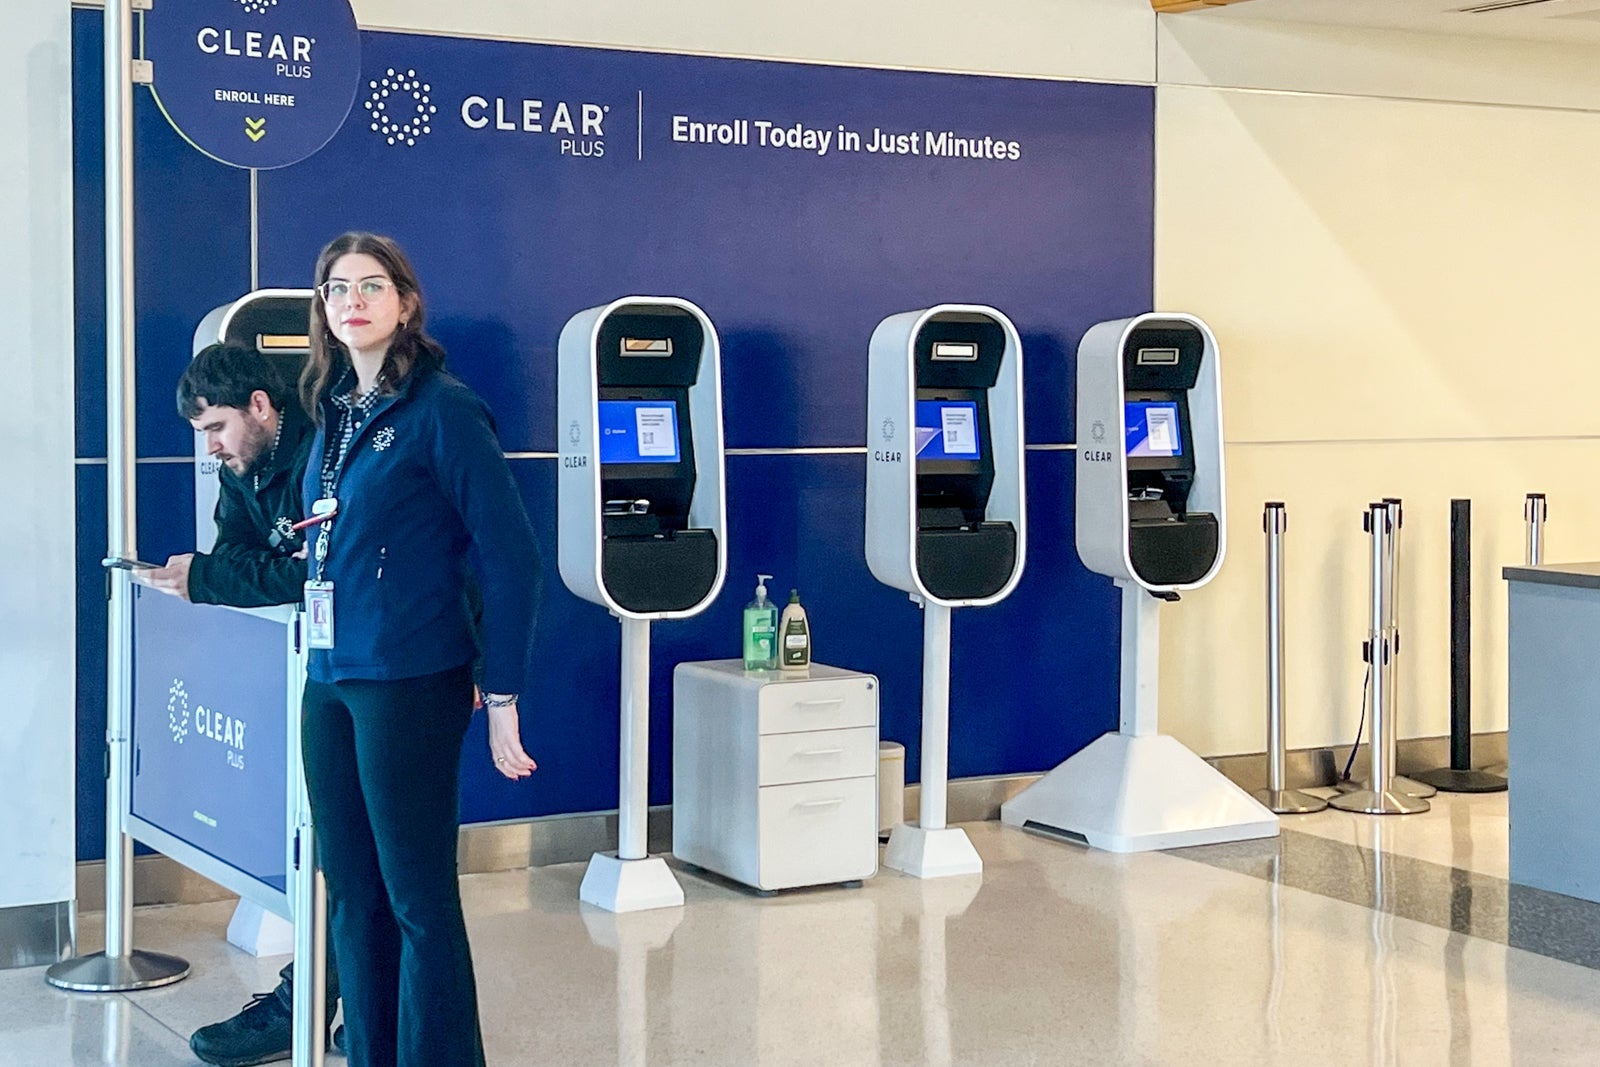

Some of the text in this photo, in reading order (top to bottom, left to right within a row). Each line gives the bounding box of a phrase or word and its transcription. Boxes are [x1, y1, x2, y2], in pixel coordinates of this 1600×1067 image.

[197, 27, 312, 62] CLEAR
[276, 63, 312, 79] PLUS
[215, 89, 295, 107] ENROLL HERE
[461, 95, 605, 136] CLEAR
[672, 115, 1021, 160] Enroll Today in Just Minutes
[560, 139, 605, 158] PLUS
[564, 456, 587, 468] CLEAR
[874, 451, 902, 463] CLEAR
[1084, 451, 1112, 462] CLEAR
[195, 705, 245, 750] CLEAR
[227, 750, 245, 770] PLUS
